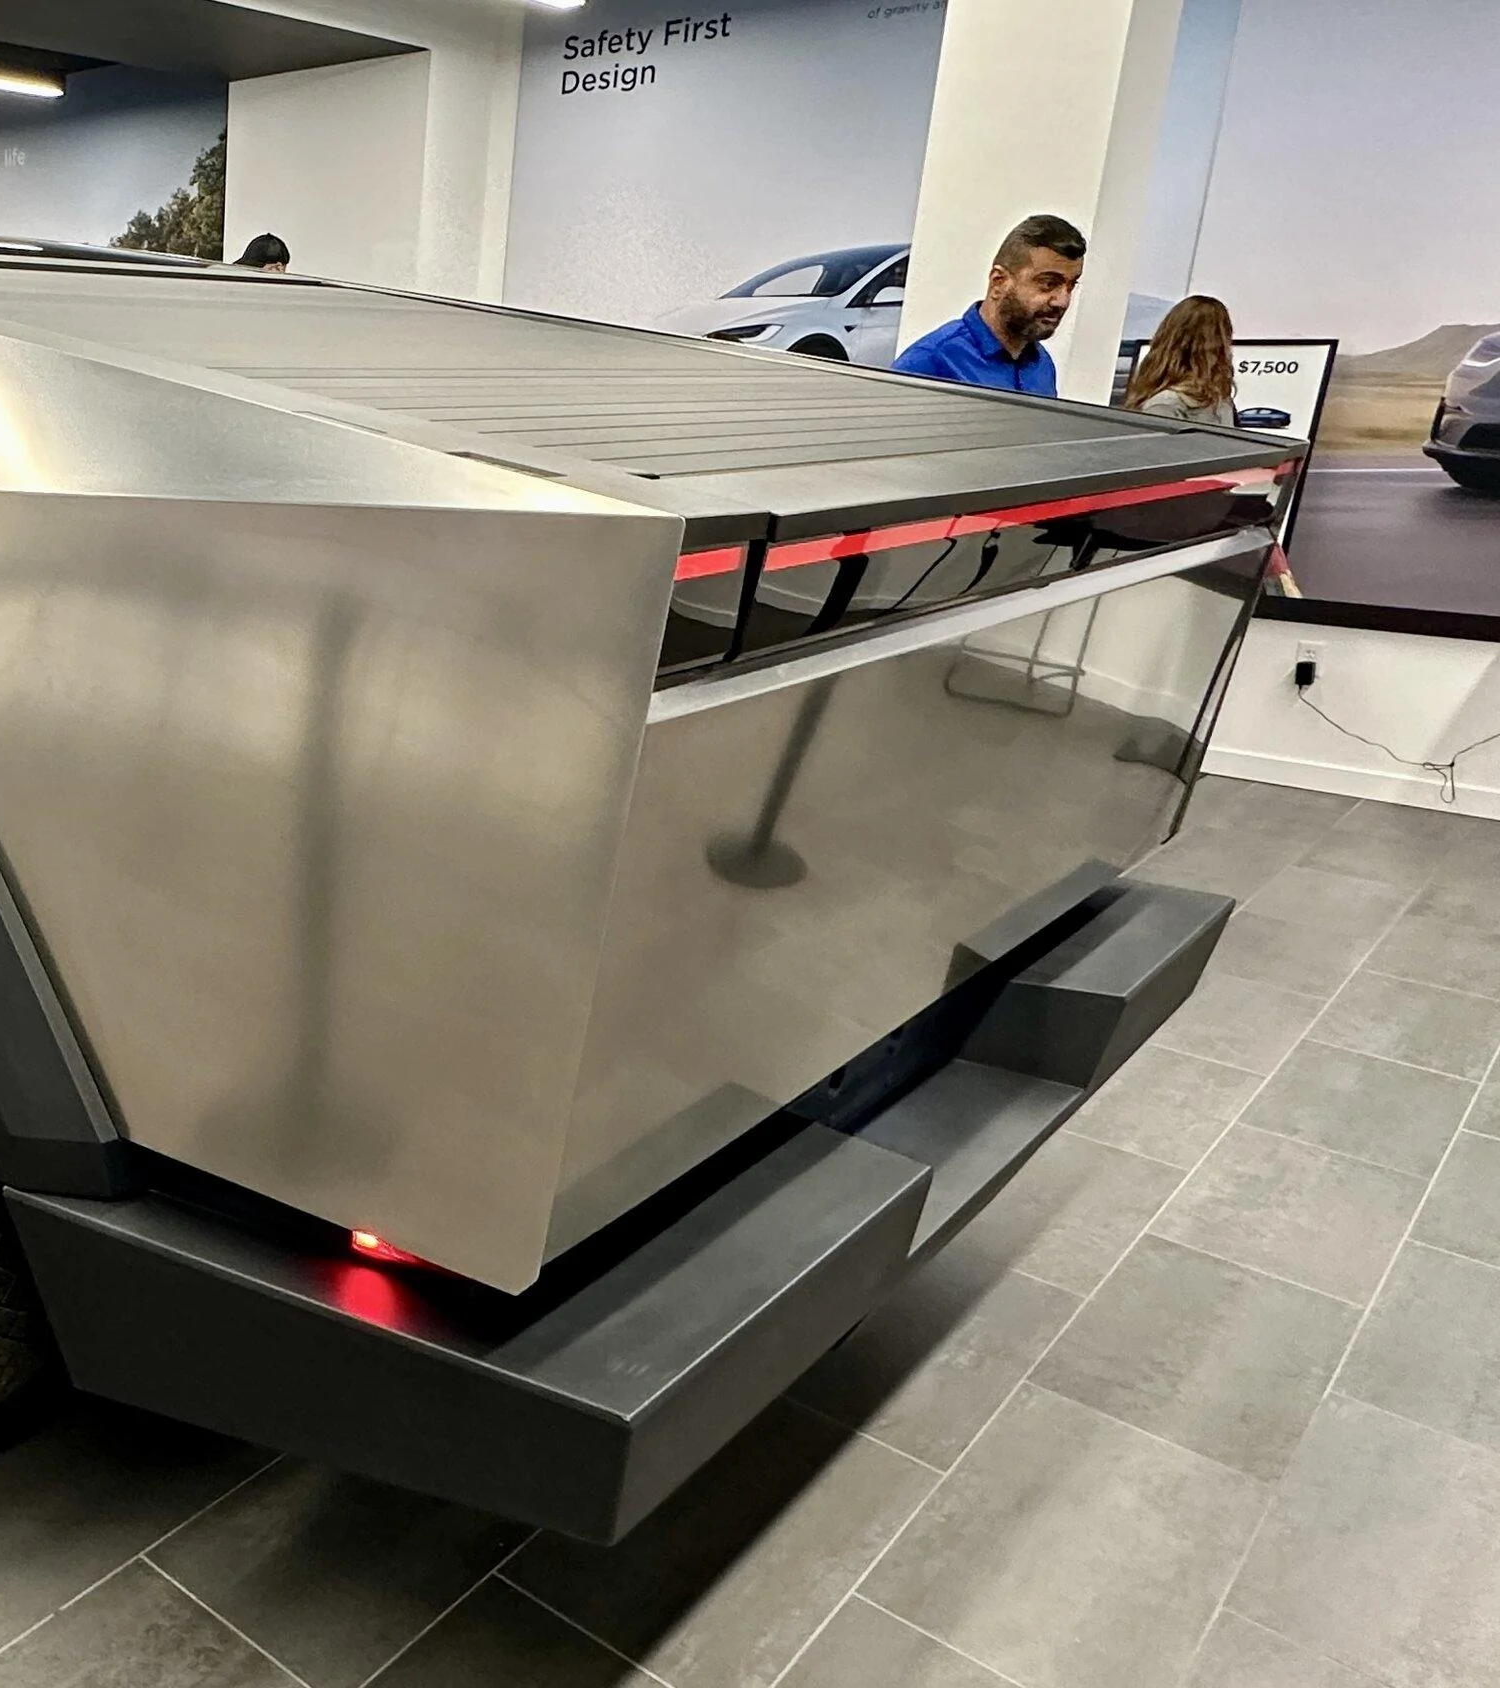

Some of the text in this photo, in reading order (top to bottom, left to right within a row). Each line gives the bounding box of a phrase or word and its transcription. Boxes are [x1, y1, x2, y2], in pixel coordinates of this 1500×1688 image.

[867, 5, 881, 19] of
[884, 2, 929, 19] gravity
[563, 12, 732, 60] Safety First
[561, 63, 656, 95] Design
[4, 147, 26, 167] life
[1238, 360, 1298, 376] $7,500
